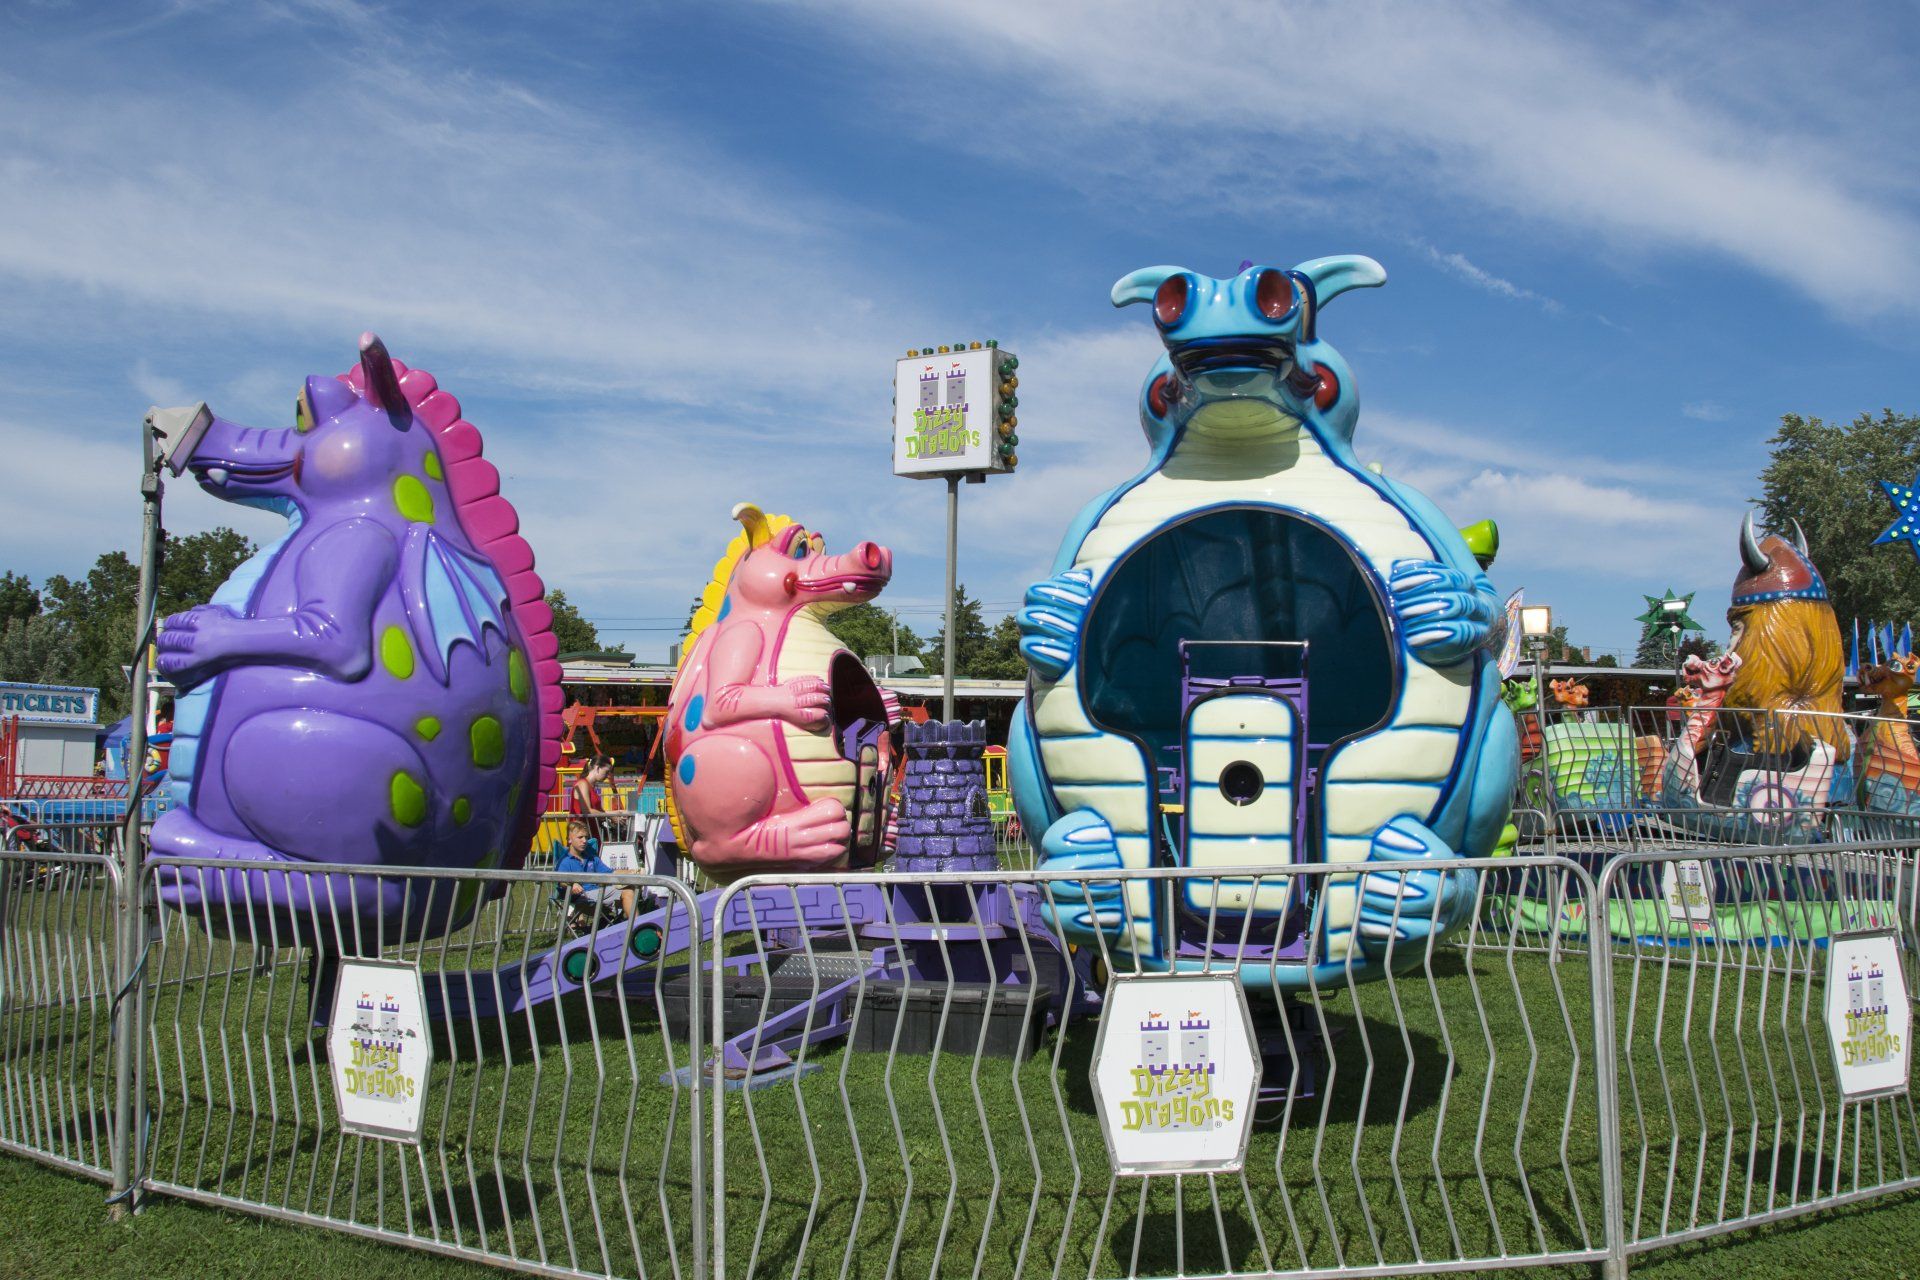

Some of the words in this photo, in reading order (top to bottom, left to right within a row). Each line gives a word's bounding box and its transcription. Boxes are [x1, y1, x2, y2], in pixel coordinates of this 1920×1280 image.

[912, 407, 963, 432] Dizzy
[904, 430, 980, 459] Dragons
[2, 692, 87, 714] TICKETS
[1844, 1010, 1887, 1037] Dizzy
[350, 1040, 399, 1074] Dizzy
[1841, 1033, 1901, 1067] Dragons
[344, 1066, 415, 1098] Dragons
[1130, 1067, 1210, 1101] Dizzy
[1120, 1096, 1234, 1131] Dragons
